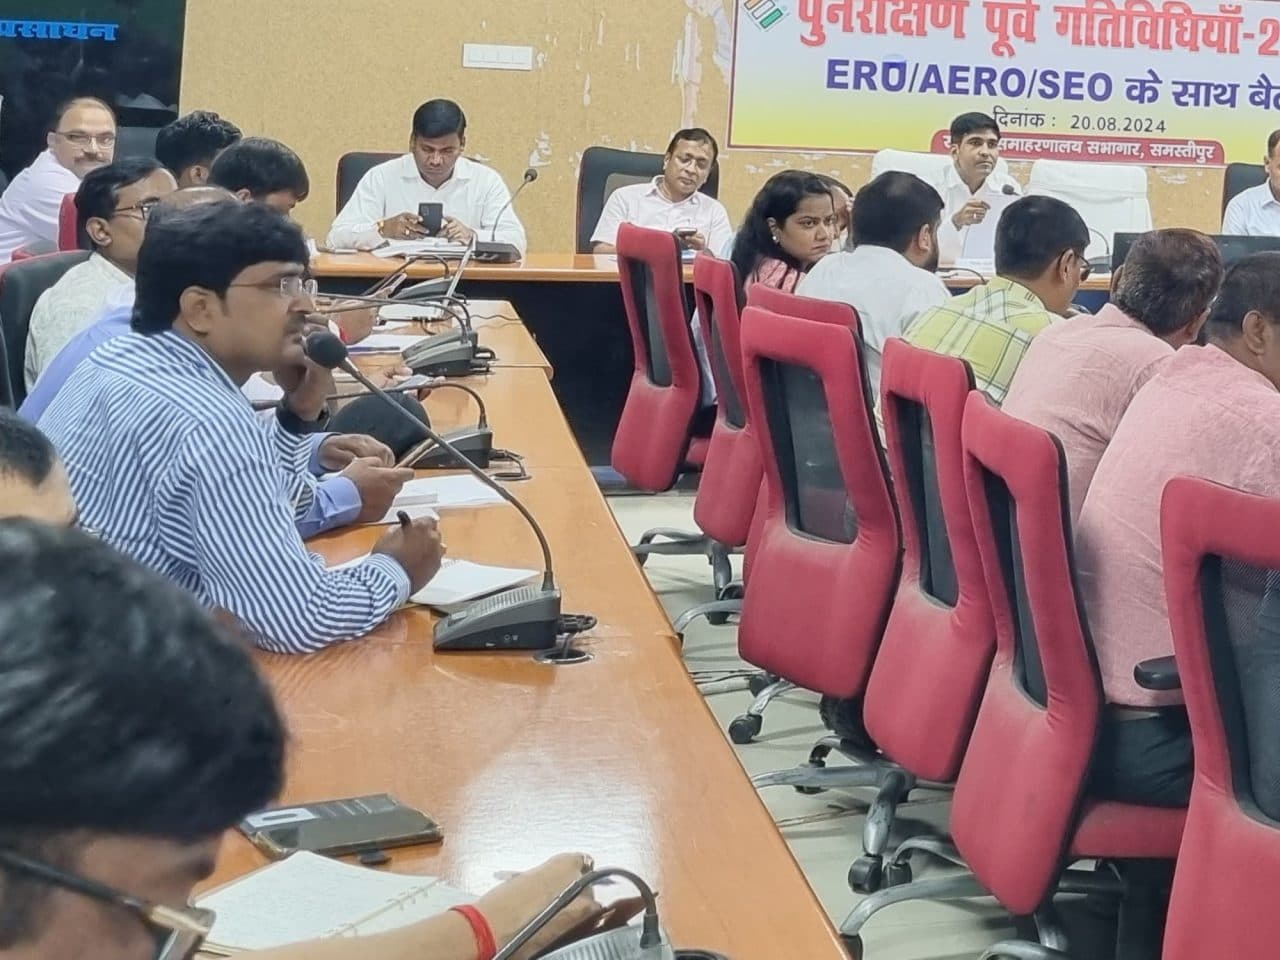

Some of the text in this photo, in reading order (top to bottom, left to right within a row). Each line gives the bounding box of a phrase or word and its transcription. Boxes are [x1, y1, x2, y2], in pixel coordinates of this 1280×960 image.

[1125, 69, 1162, 104] के
[1171, 80, 1240, 108] साथ
[993, 105, 1046, 128] दिनांक
[1071, 115, 1167, 133] 20.08.2024
[1150, 139, 1216, 164] समस्तीपुर
